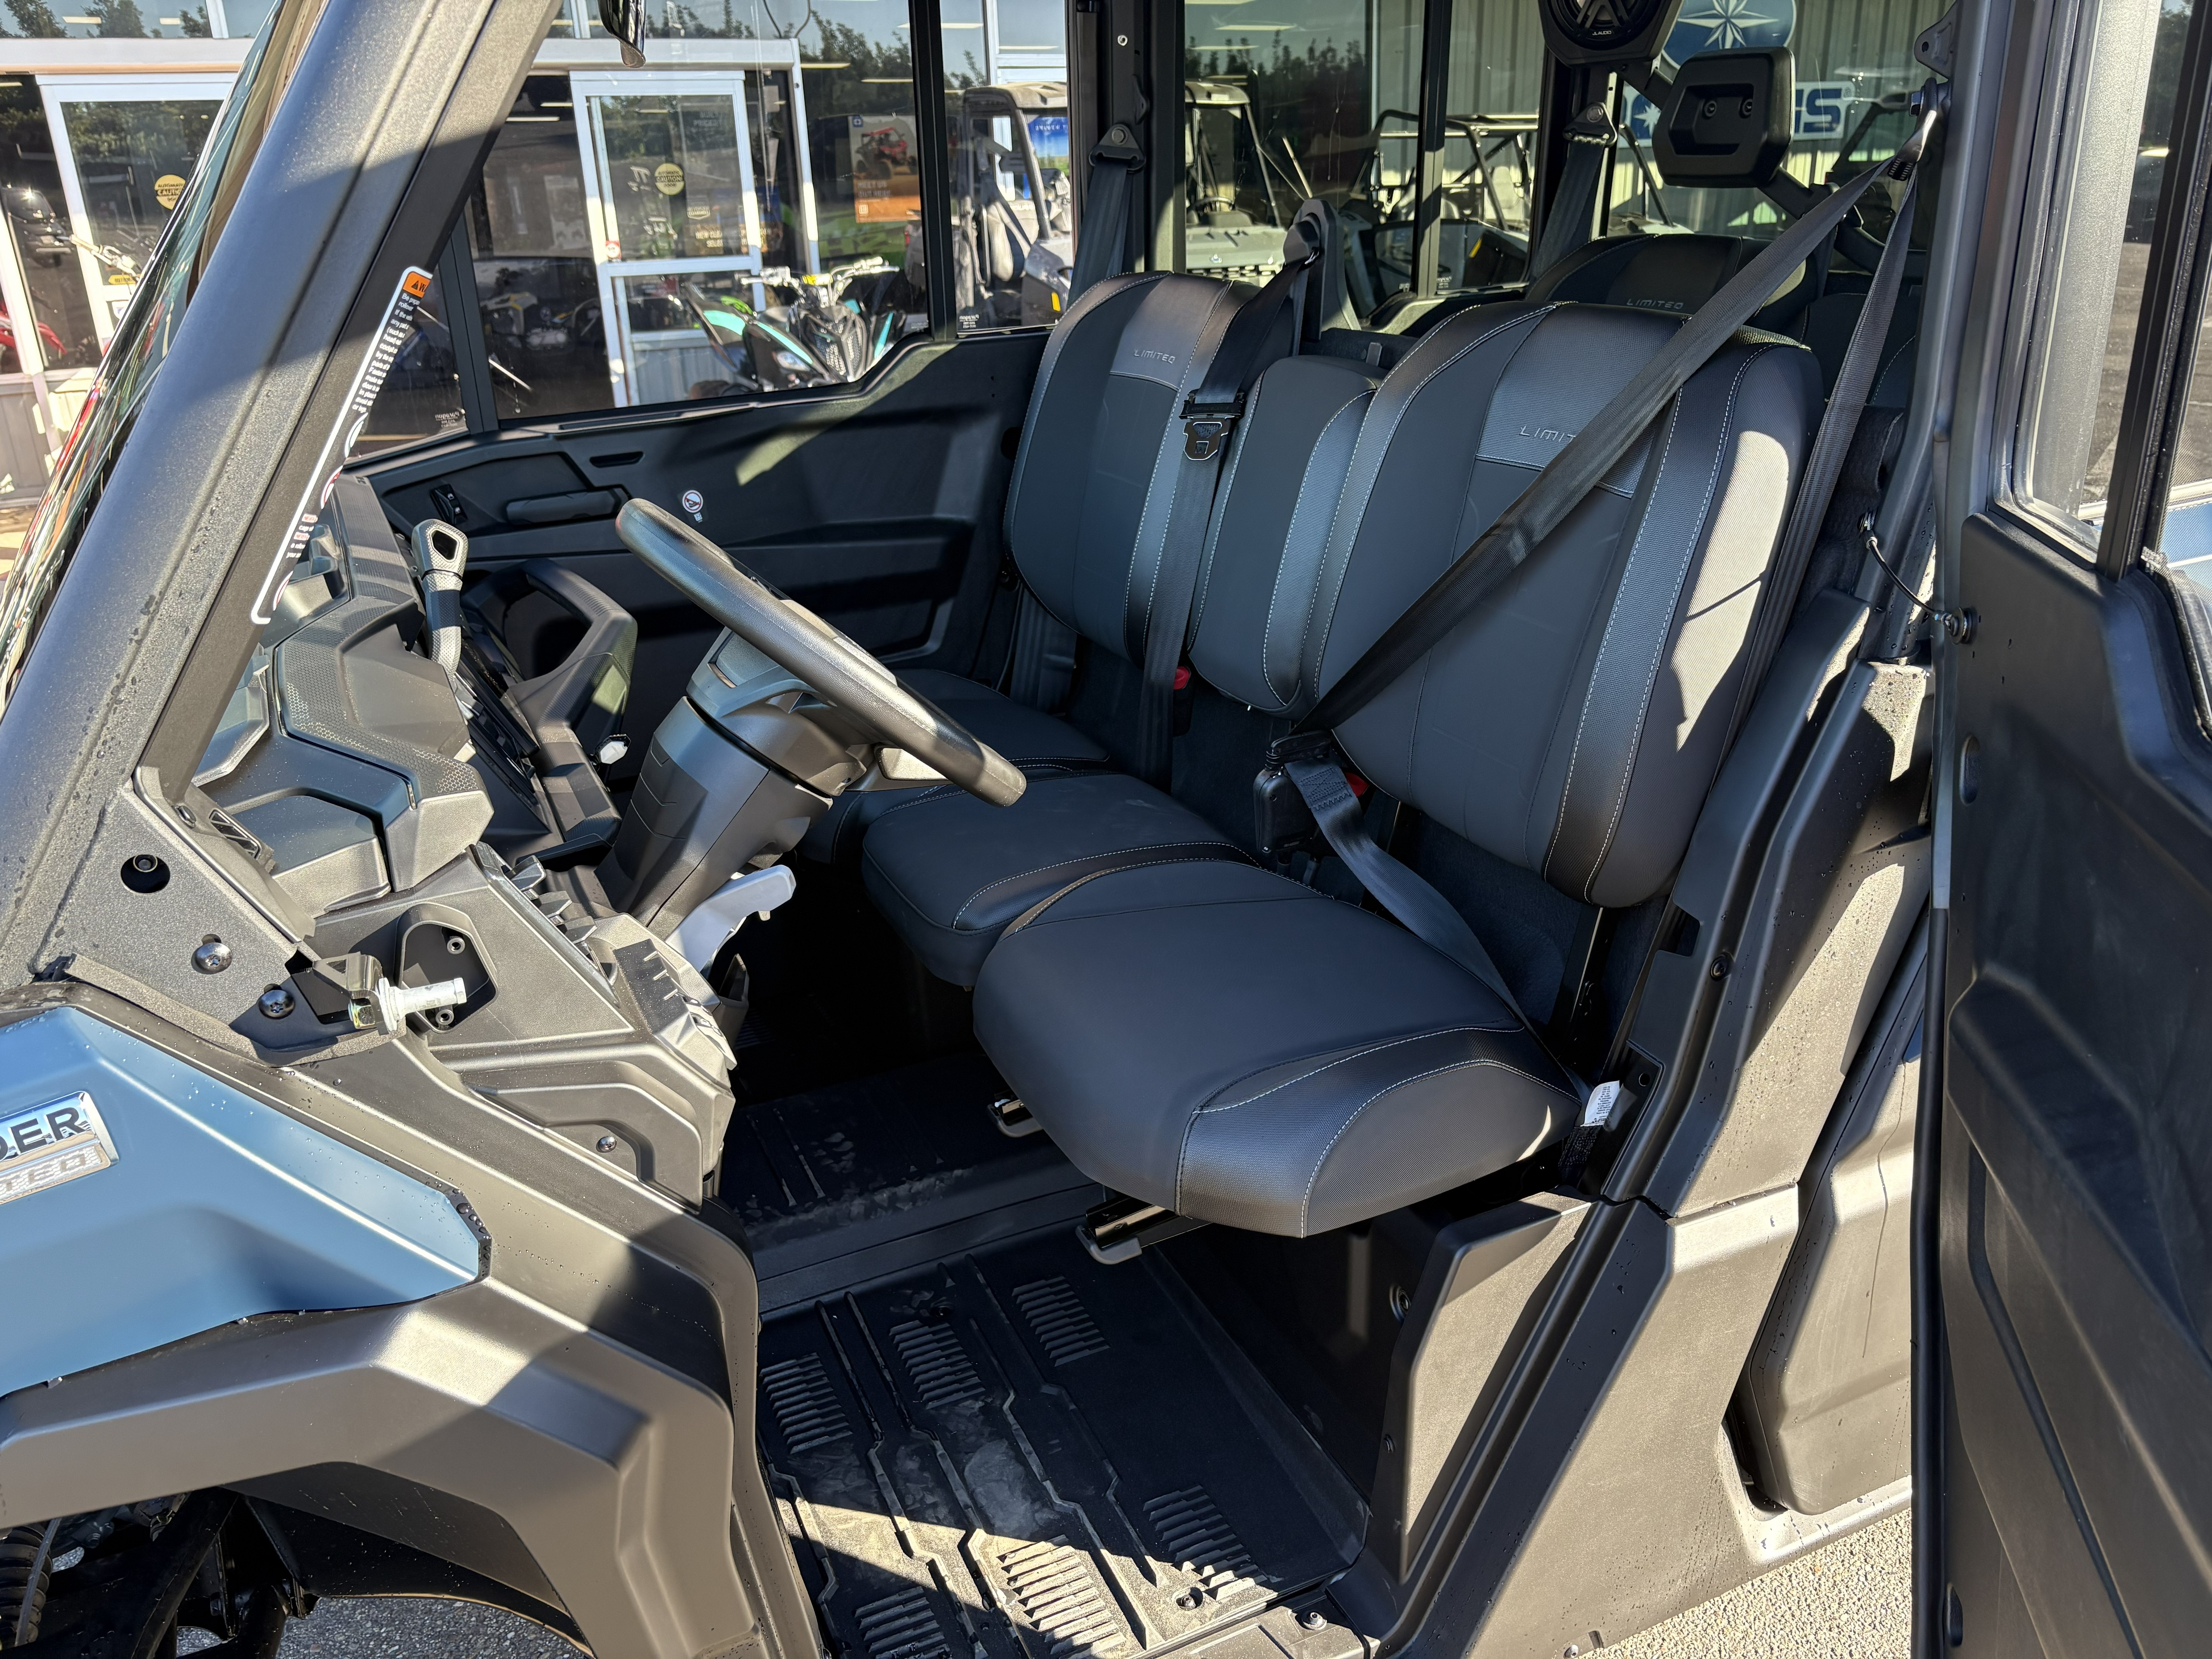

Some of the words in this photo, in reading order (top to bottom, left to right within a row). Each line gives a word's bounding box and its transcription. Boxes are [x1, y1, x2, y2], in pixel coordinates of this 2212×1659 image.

[402, 293, 410, 301] Be
[1626, 299, 1684, 309] LIMITED
[1134, 349, 1176, 364] LIMITED
[1520, 426, 1577, 444] LIMIT
[0, 1107, 86, 1161] ER
